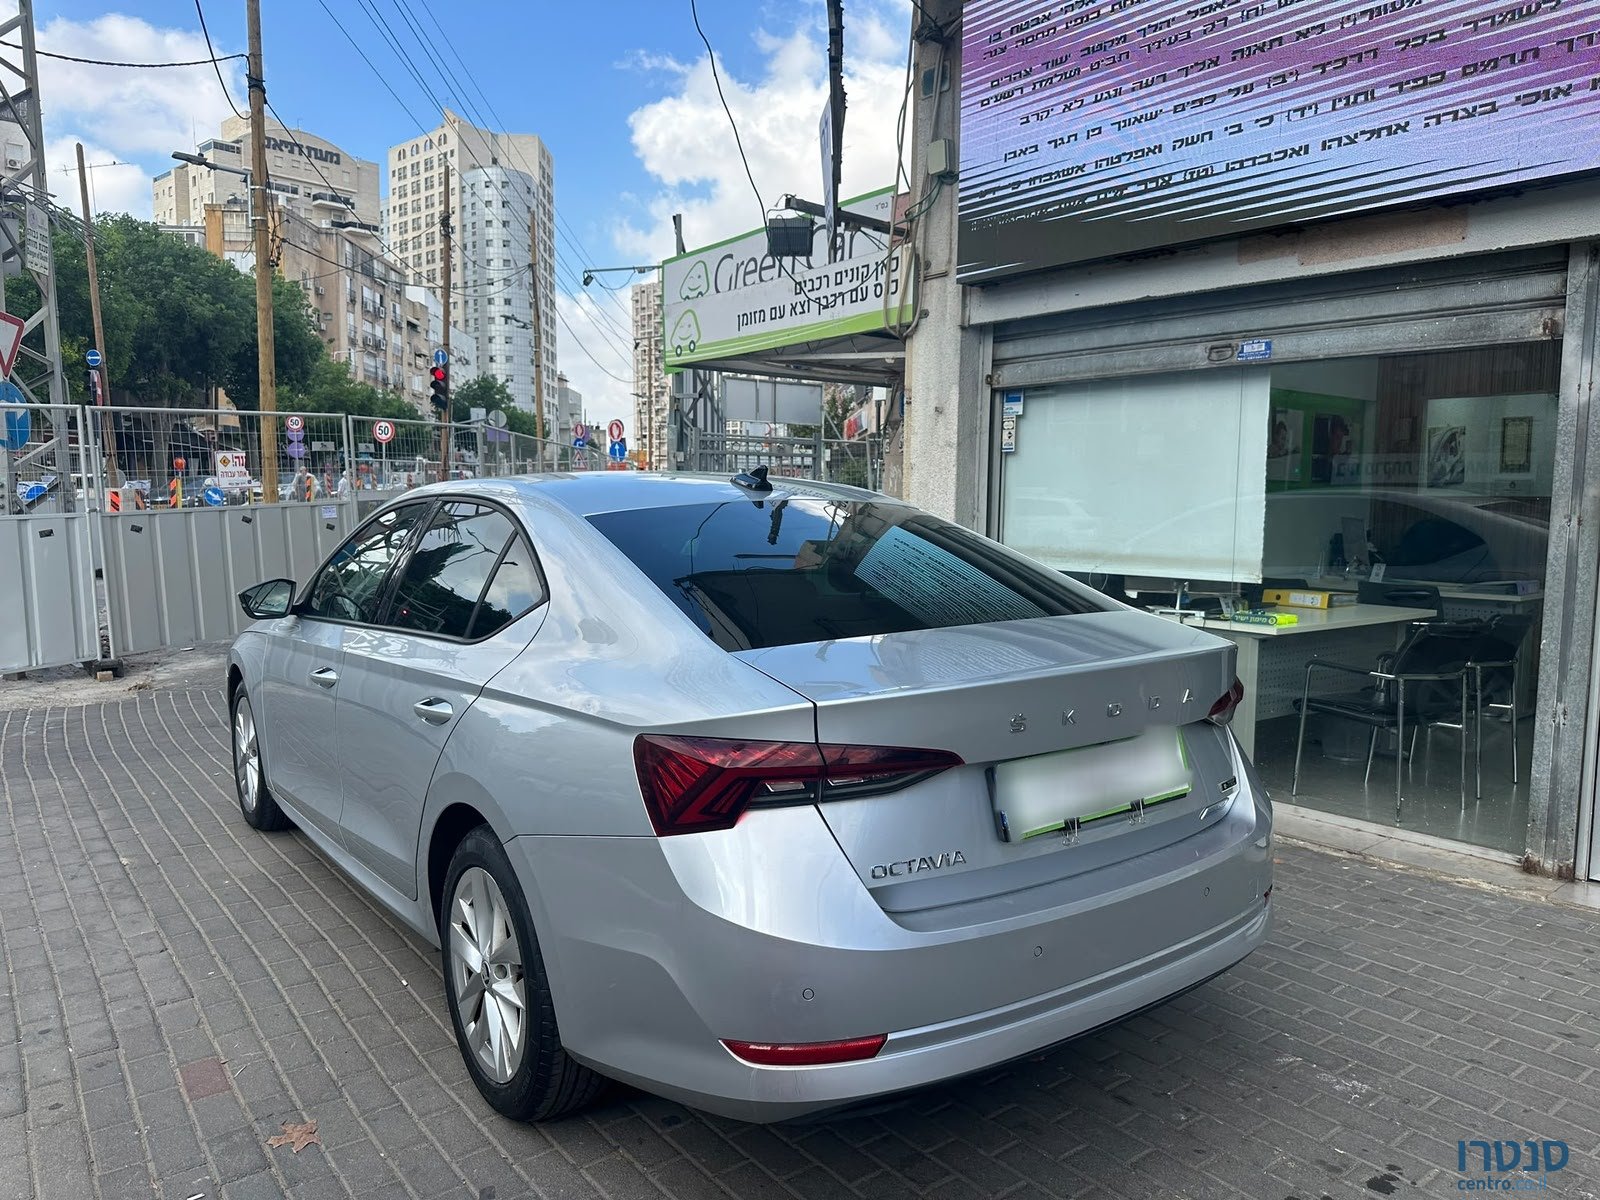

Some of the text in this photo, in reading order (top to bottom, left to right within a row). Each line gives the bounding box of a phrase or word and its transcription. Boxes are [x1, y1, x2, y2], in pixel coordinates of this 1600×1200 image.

[1010, 12, 1051, 34] אבטח
[1137, 16, 1176, 37] יהלך
[1203, 16, 1228, 35] רק
[988, 31, 1002, 43] בו
[1090, 50, 1130, 71] תביט
[1177, 55, 1220, 78] אליך
[991, 67, 1032, 88] צהרים
[1131, 73, 1167, 92] רעה
[980, 87, 1024, 107] רשעים
[1228, 82, 1255, 98] על
[1062, 98, 1084, 113] לא
[1173, 93, 1217, 115] כפים
[1020, 108, 1054, 126] יקרב
[1254, 114, 1275, 128] כי
[1424, 101, 1498, 128] בצרה
[1086, 126, 1102, 140] פן
[1224, 122, 1244, 136] בי
[1321, 120, 1410, 151] אחלצהו
[1172, 130, 1214, 152] חשק
[1003, 144, 1039, 163] באבן
[1094, 143, 1163, 170] ואפלטהו
[1226, 144, 1309, 172] ואכבדהו
[793, 274, 829, 296] רכבים
[835, 264, 870, 287] קונים
[850, 285, 868, 304] עם
[874, 279, 899, 300] כס
[770, 304, 786, 321] עם
[789, 299, 811, 317] וצא
[737, 308, 766, 332] מזומן
[290, 418, 300, 427] 50
[378, 425, 390, 436] 50
